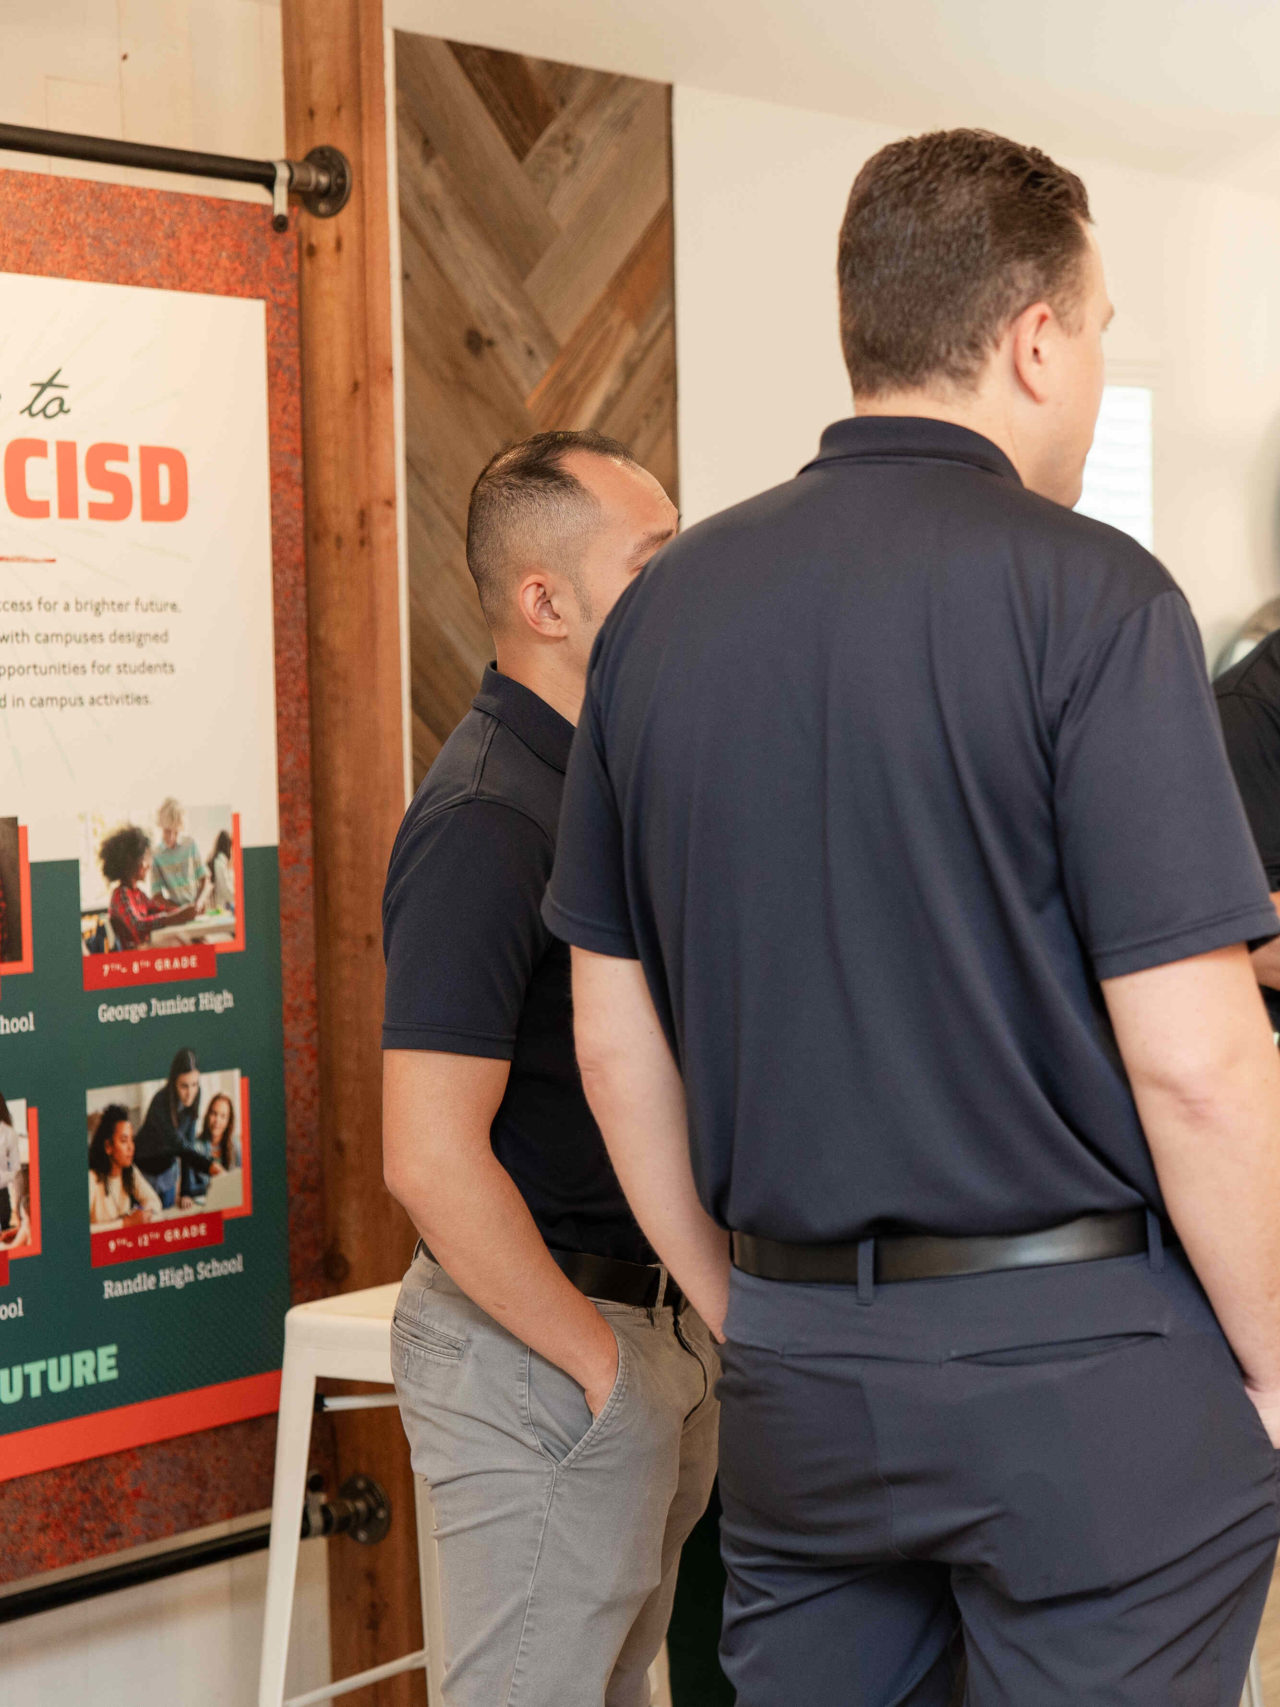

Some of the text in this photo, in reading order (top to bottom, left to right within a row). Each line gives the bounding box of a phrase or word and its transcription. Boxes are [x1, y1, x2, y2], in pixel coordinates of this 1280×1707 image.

[19, 368, 71, 419] to
[3, 437, 190, 523] CISD
[0, 596, 182, 617] cess for a brighter future.
[0, 629, 169, 649] with campuses designed
[91, 660, 111, 675] for
[116, 659, 176, 675] students
[11, 694, 25, 708] in
[30, 695, 85, 712] campus
[154, 955, 198, 972] GRADE
[98, 989, 234, 1023] George Junior High
[0, 1011, 35, 1035] hool
[164, 1223, 207, 1242] GRADE
[103, 1253, 243, 1299] Randle High School
[0, 1344, 119, 1404] UTURE
